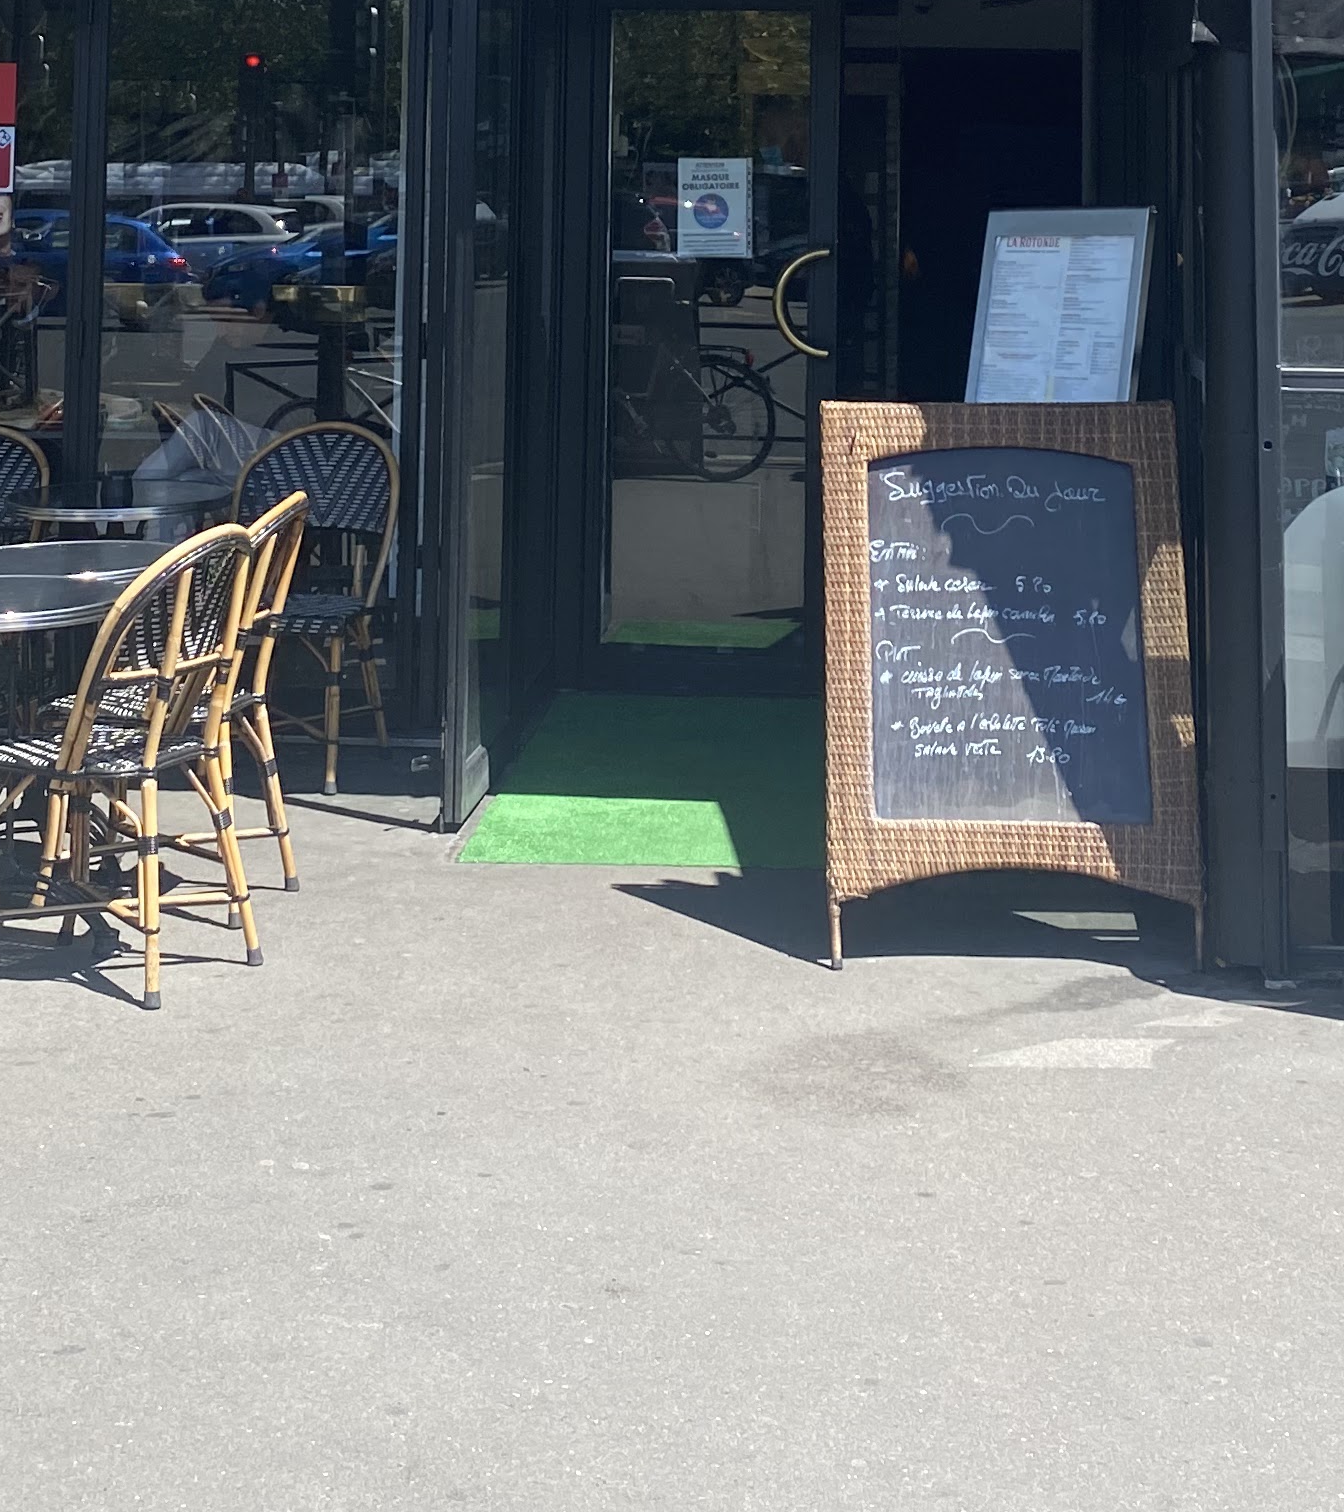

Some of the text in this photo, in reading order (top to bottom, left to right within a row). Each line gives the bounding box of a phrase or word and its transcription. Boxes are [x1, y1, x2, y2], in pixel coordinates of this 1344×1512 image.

[691, 174, 730, 182] MASQUE
[682, 182, 740, 191] OBLIGATOIRE
[1006, 236, 1061, 248] LA ROTONDE
